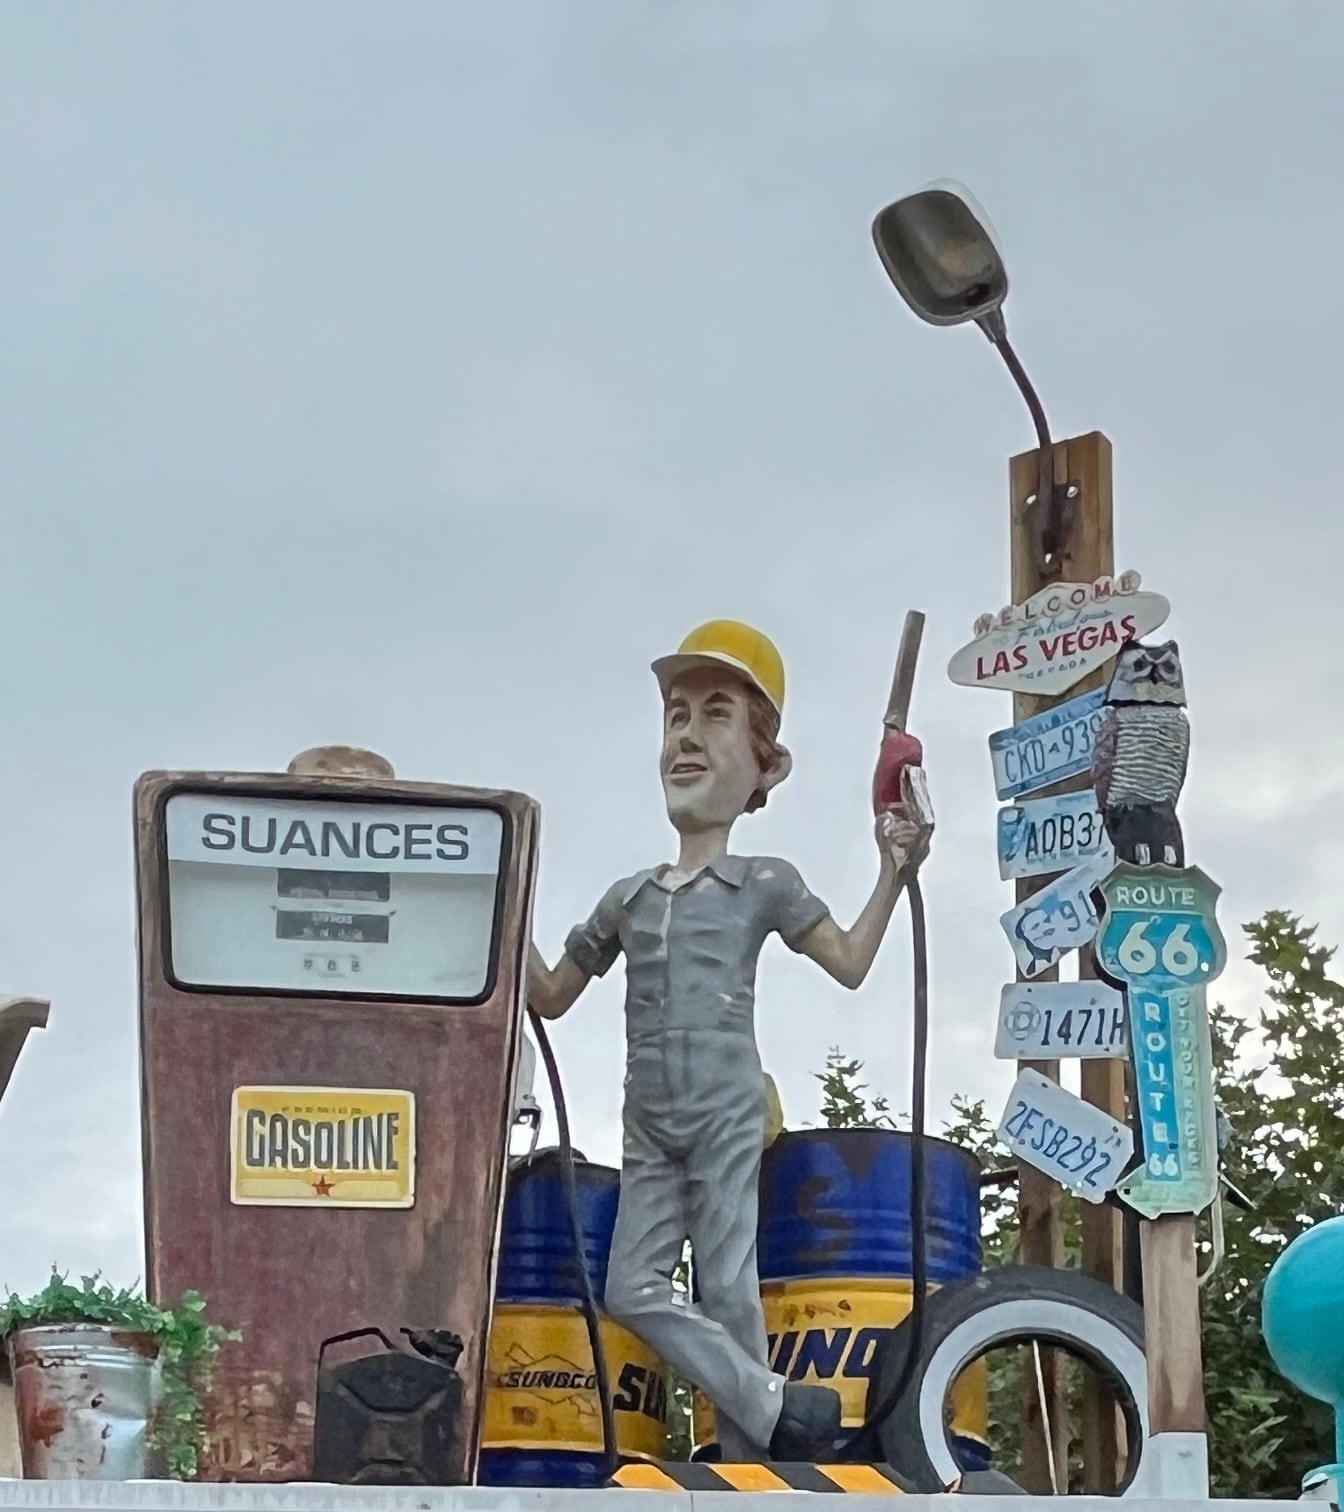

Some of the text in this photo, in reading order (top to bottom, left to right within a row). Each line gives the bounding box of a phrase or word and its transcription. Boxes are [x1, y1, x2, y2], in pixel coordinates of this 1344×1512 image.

[976, 575, 1135, 633] WELCOME
[976, 614, 1136, 681] LAS VEGAS
[201, 813, 469, 861] SUANCES
[1116, 886, 1195, 906] ROUTE
[1118, 920, 1198, 977] 66
[1040, 1007, 1124, 1046] 1471H
[246, 1109, 400, 1170] GASOLINE
[1148, 1153, 1179, 1176] 66
